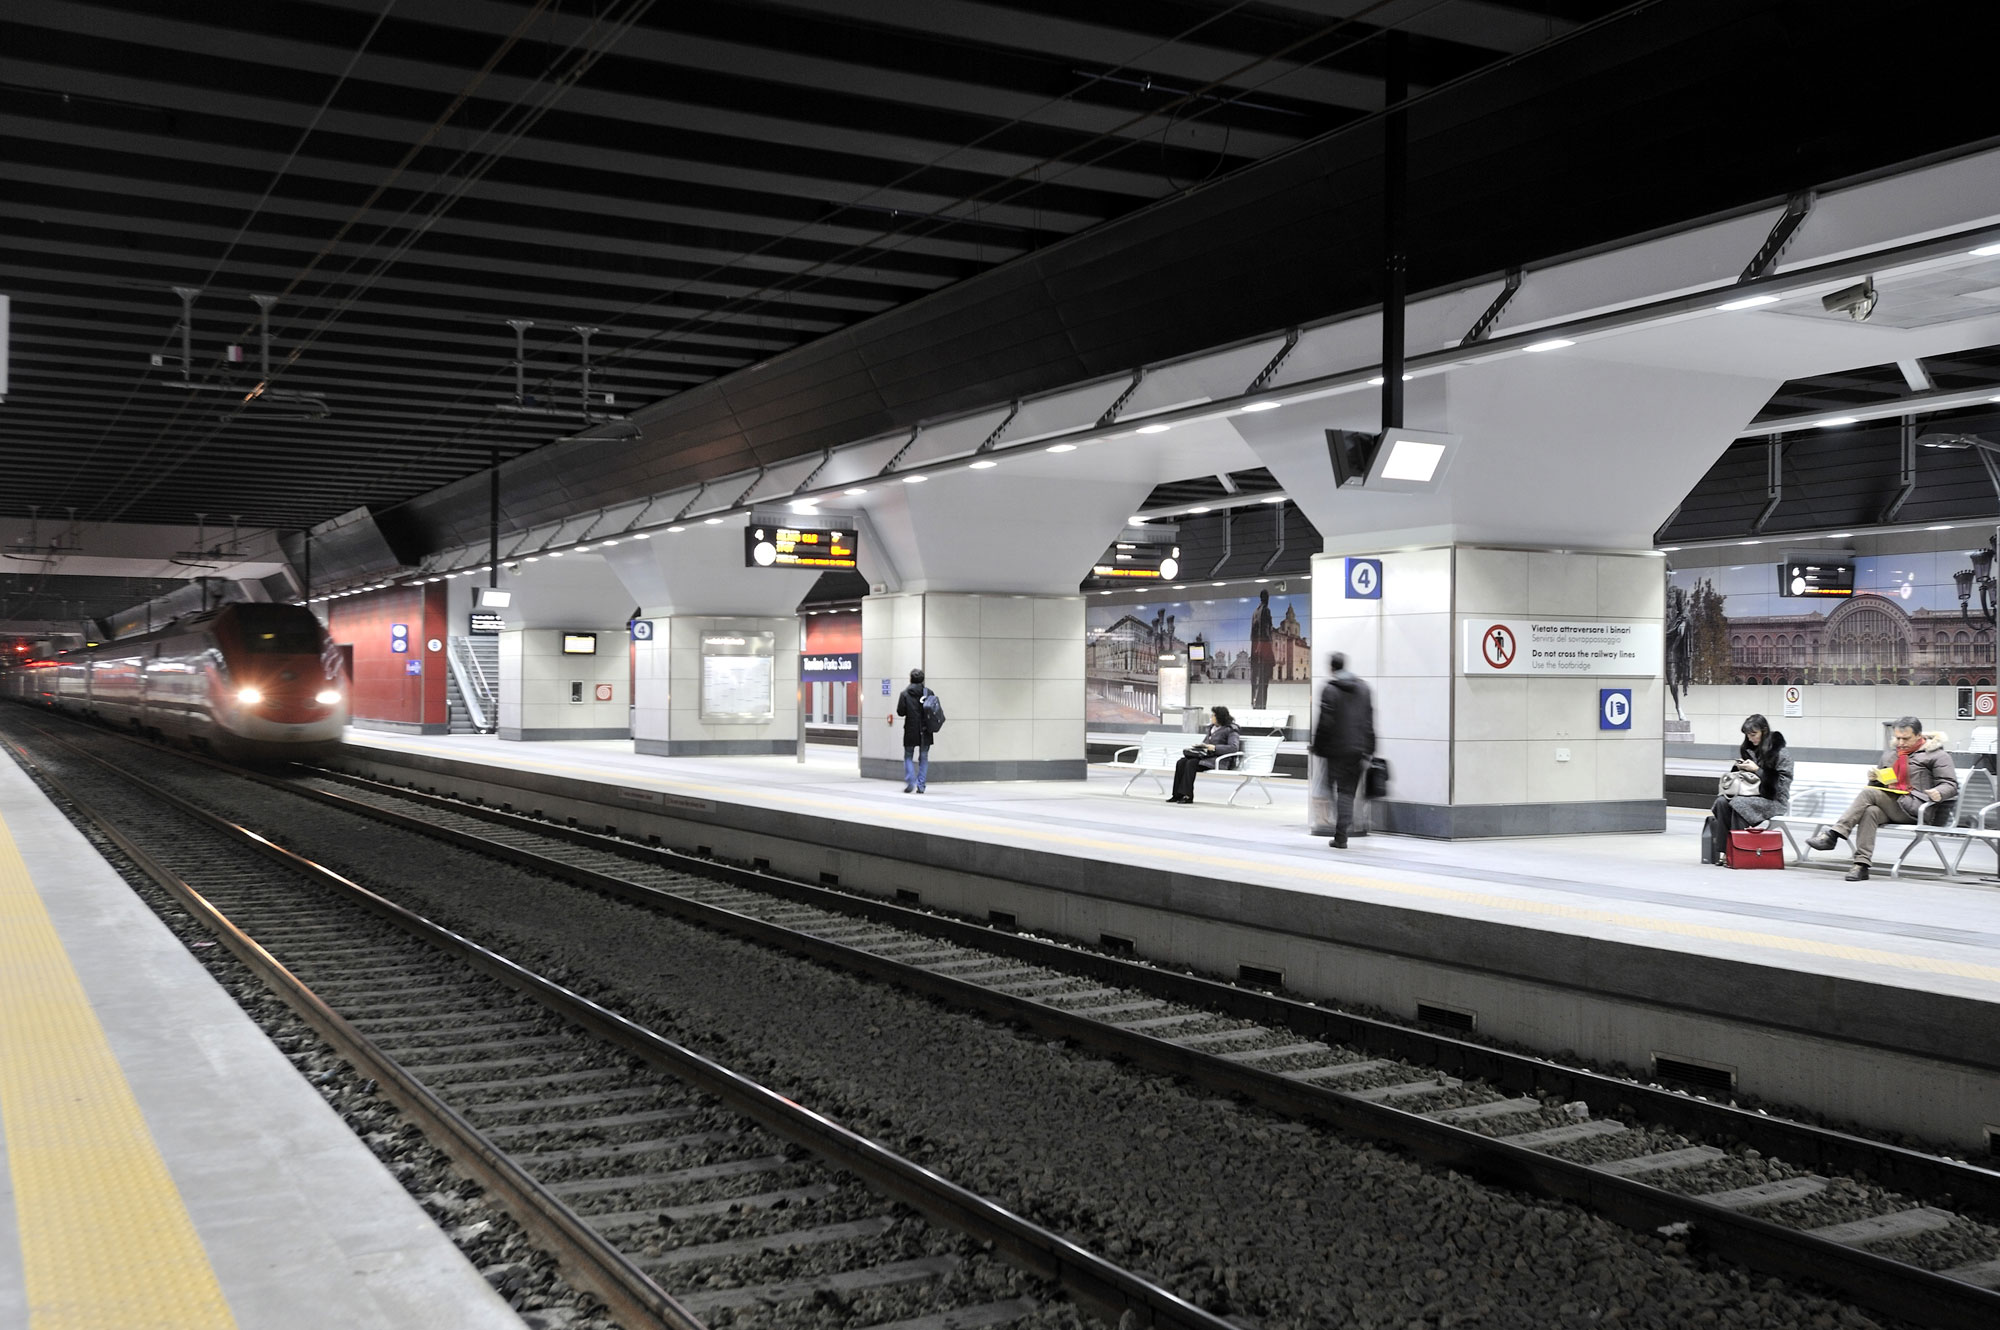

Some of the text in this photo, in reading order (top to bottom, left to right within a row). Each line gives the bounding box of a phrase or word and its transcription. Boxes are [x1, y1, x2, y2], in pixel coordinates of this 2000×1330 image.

[1358, 568, 1370, 589] 4
[638, 626, 646, 636] 4
[1531, 624, 1559, 633] Vietato
[1560, 625, 1605, 634] attraversare
[1610, 626, 1631, 634] binari
[1532, 634, 1555, 643] Servirsi
[1556, 634, 1567, 643] del
[1532, 649, 1542, 658] Do
[1544, 650, 1556, 658] not
[1577, 650, 1589, 658] the
[1590, 650, 1617, 660] railway
[1619, 650, 1636, 658] lines
[1531, 661, 1591, 671] Use the footbridge
